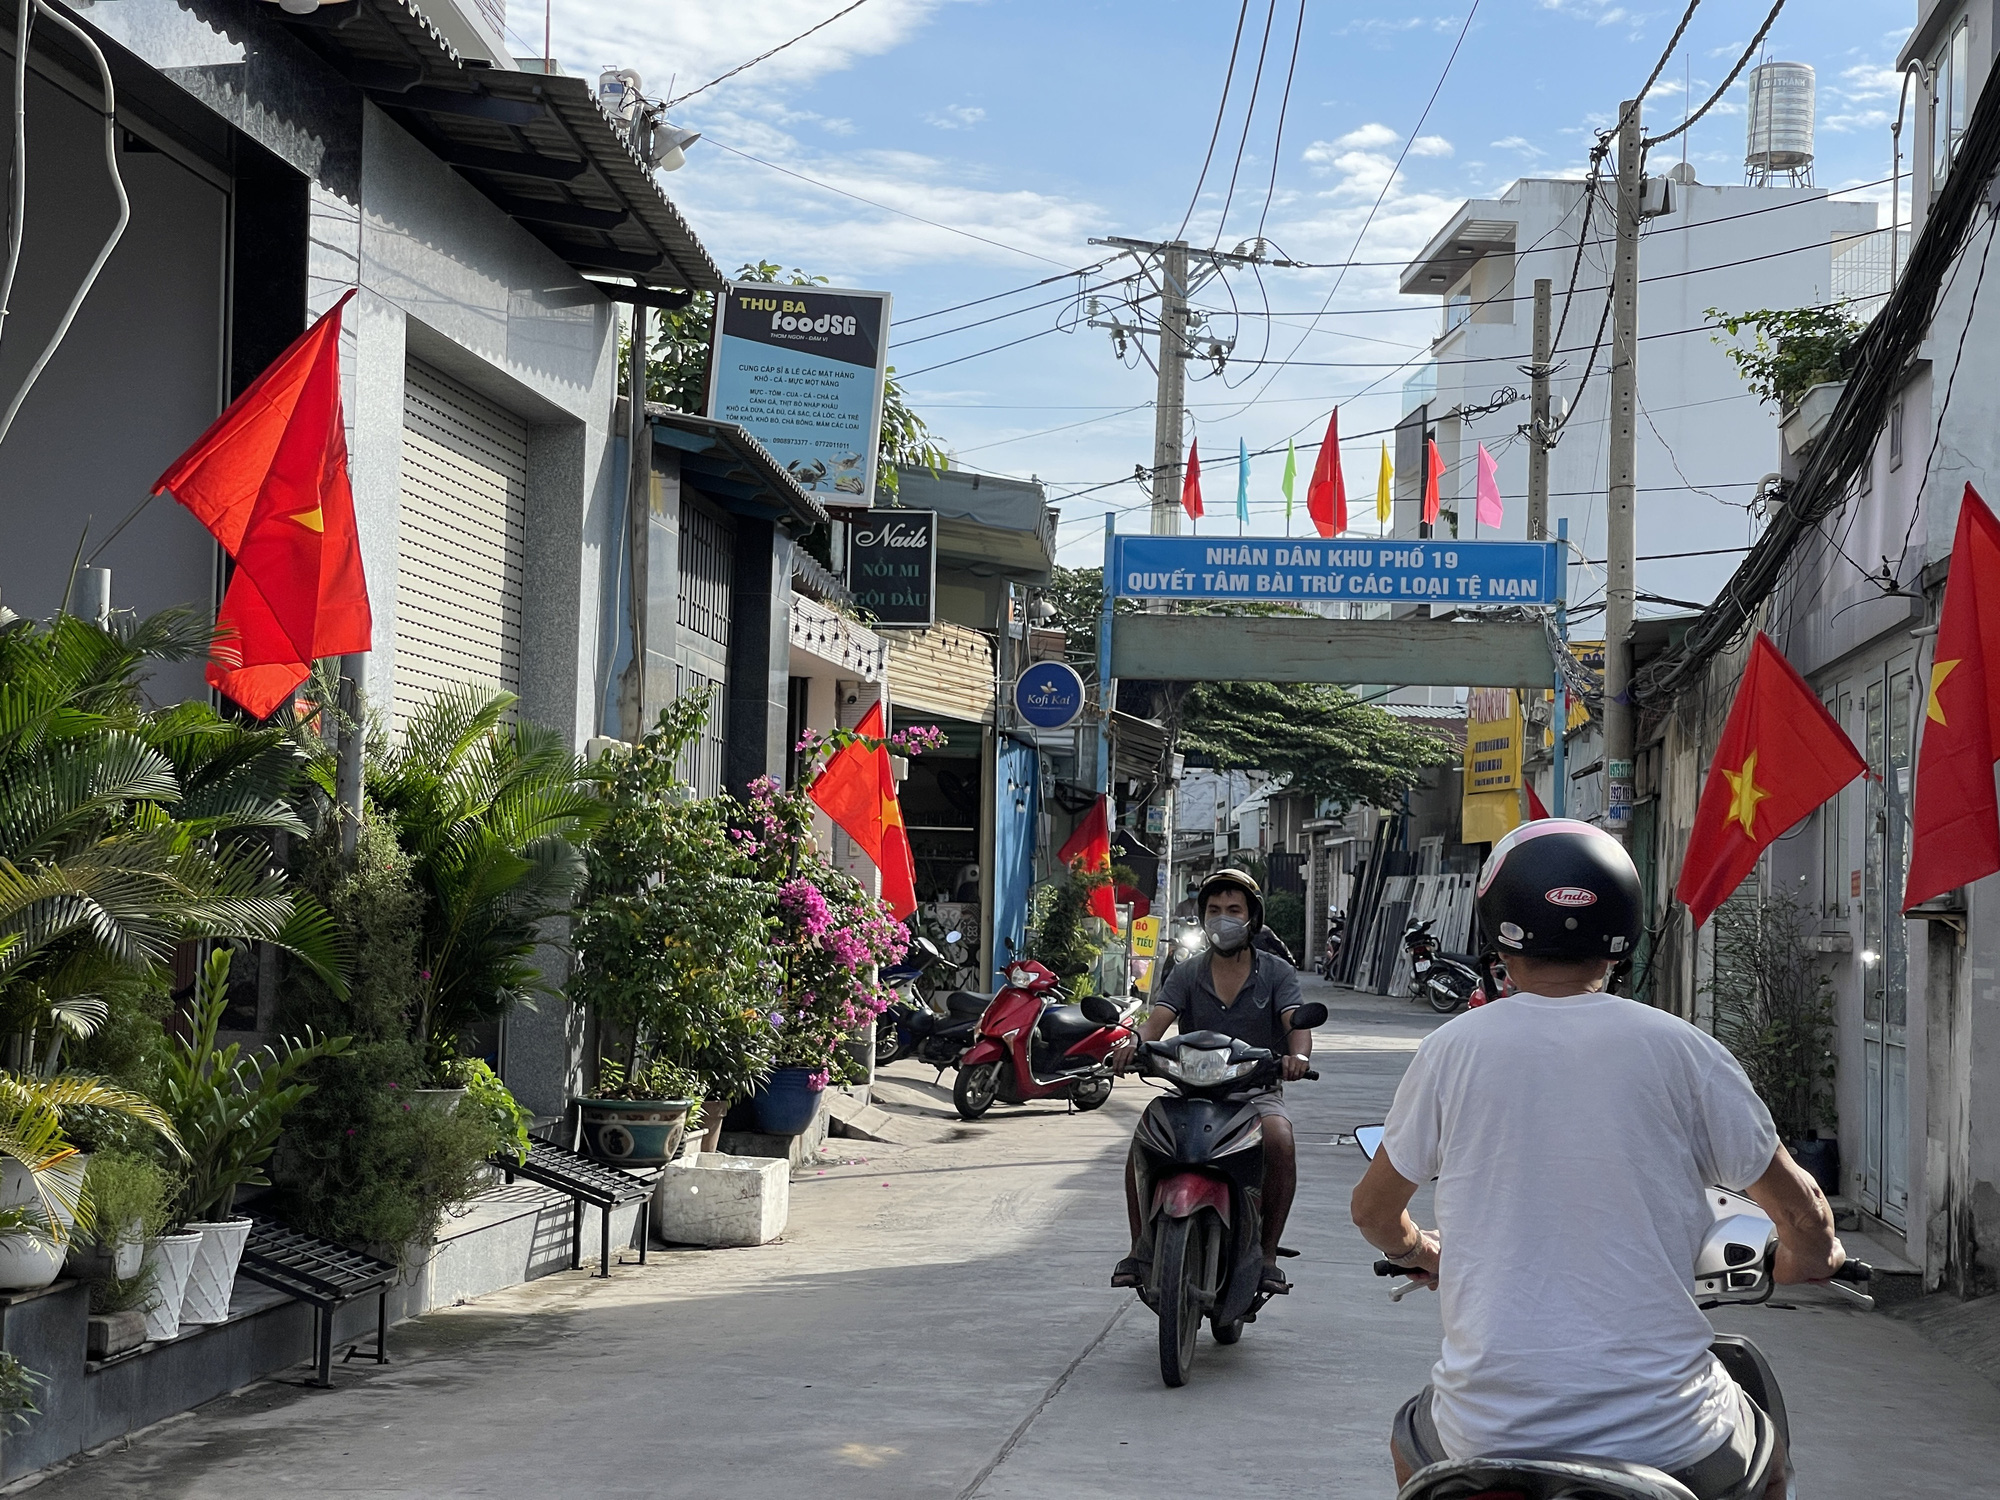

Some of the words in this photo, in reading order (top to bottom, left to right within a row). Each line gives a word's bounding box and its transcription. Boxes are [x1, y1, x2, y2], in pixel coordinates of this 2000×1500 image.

[739, 297, 777, 312] THU
[782, 300, 806, 313] BA
[771, 310, 856, 336] foodSG
[738, 364, 759, 372] CUNG
[802, 368, 816, 376] CÁC
[788, 377, 803, 385] MỰC
[855, 523, 927, 548] Nails
[1206, 544, 1268, 565] NHÂN
[1275, 545, 1320, 566] DÂN
[1328, 549, 1372, 567] KHU
[1380, 545, 1425, 568] PHỐ
[1432, 551, 1458, 569] 19
[900, 564, 919, 577] MI
[1128, 568, 1196, 591] QUYẾT
[1202, 570, 1249, 591] TÂM
[1256, 571, 1293, 592] BÀI
[1300, 572, 1344, 593] TRỪ
[1349, 572, 1393, 594] CÁC
[1400, 577, 1449, 598] LOẠI
[1456, 574, 1481, 599] TỆ
[1489, 579, 1537, 600] NẠN
[891, 586, 927, 606] ĐẦU
[1027, 694, 1048, 707] Kofi
[1135, 920, 1148, 931] BÒ
